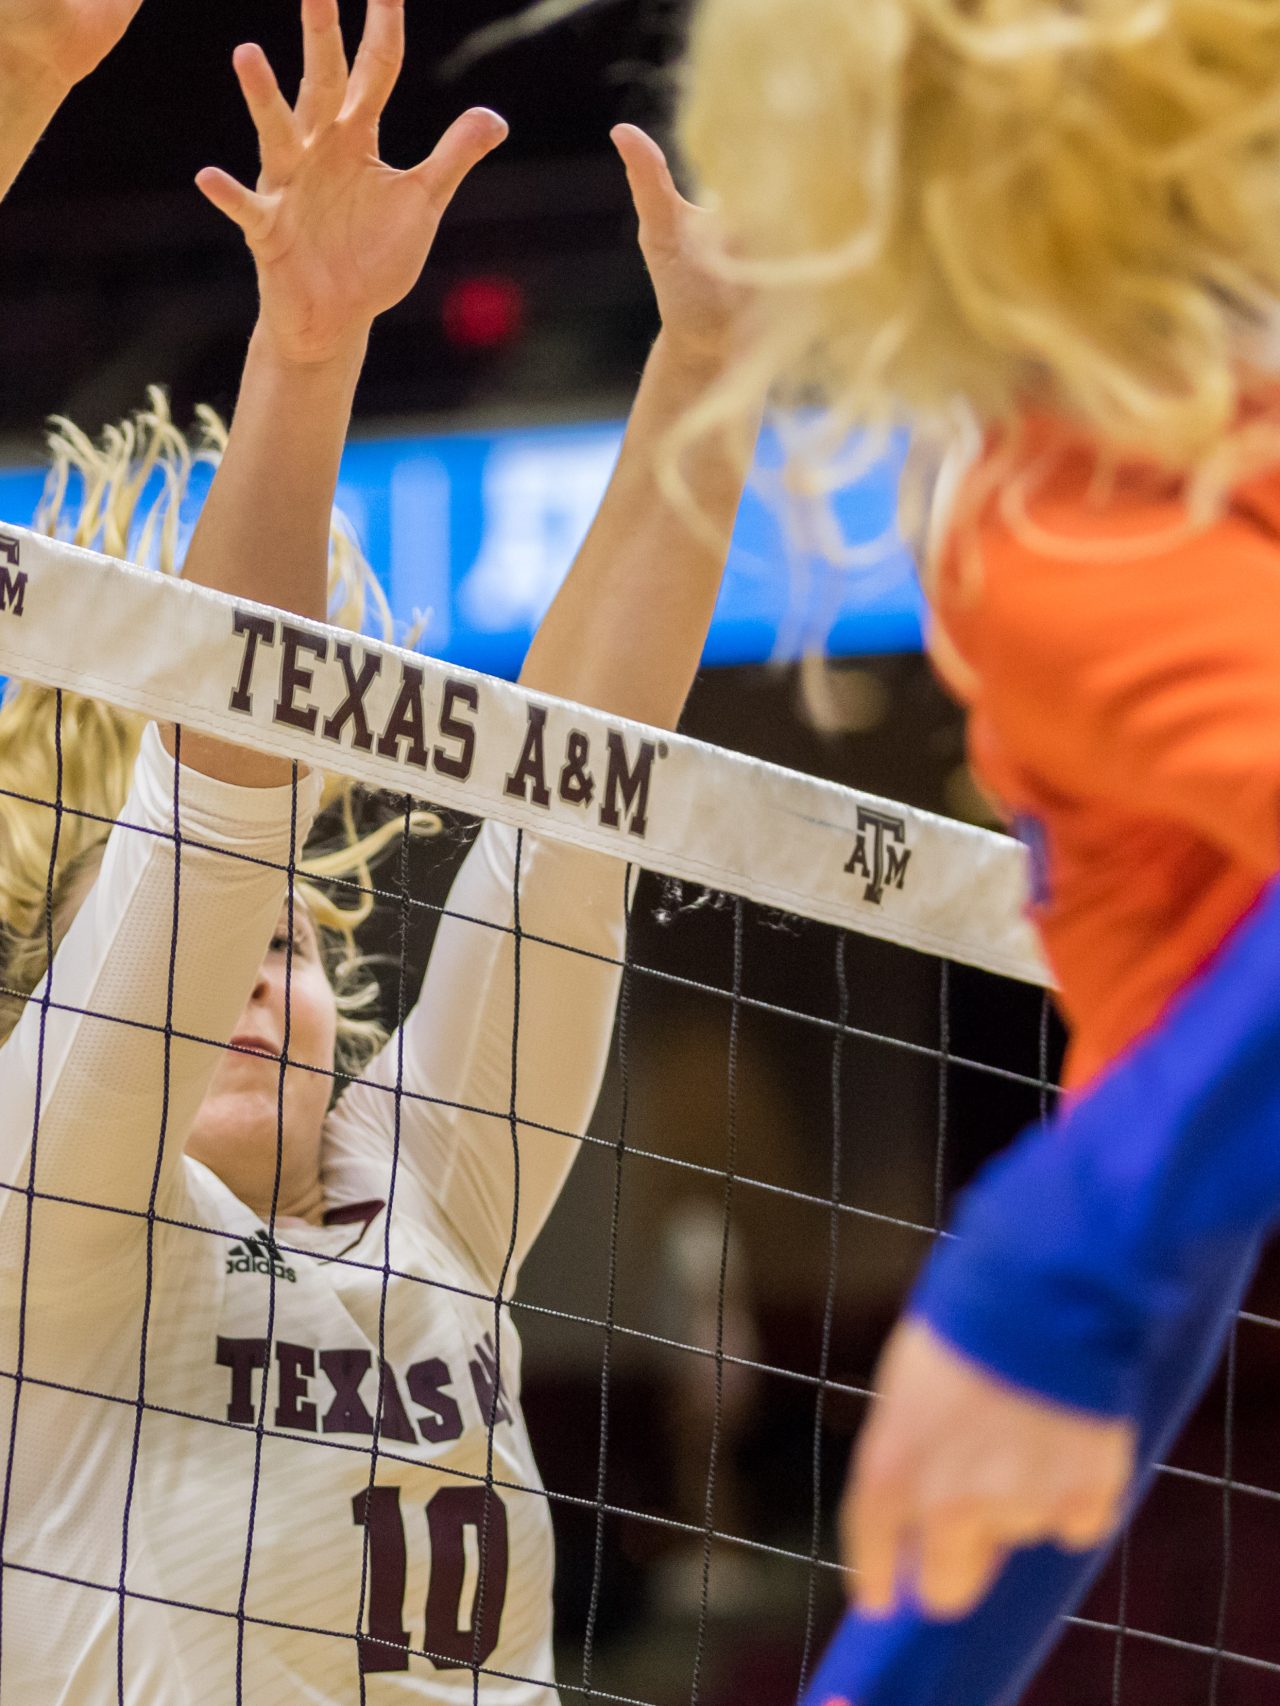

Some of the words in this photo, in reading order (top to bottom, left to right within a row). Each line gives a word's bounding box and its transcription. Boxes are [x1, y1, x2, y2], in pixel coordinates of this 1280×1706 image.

[228, 609, 480, 783] TEXAS
[503, 703, 657, 839] A&M
[351, 1485, 510, 1674] 10
